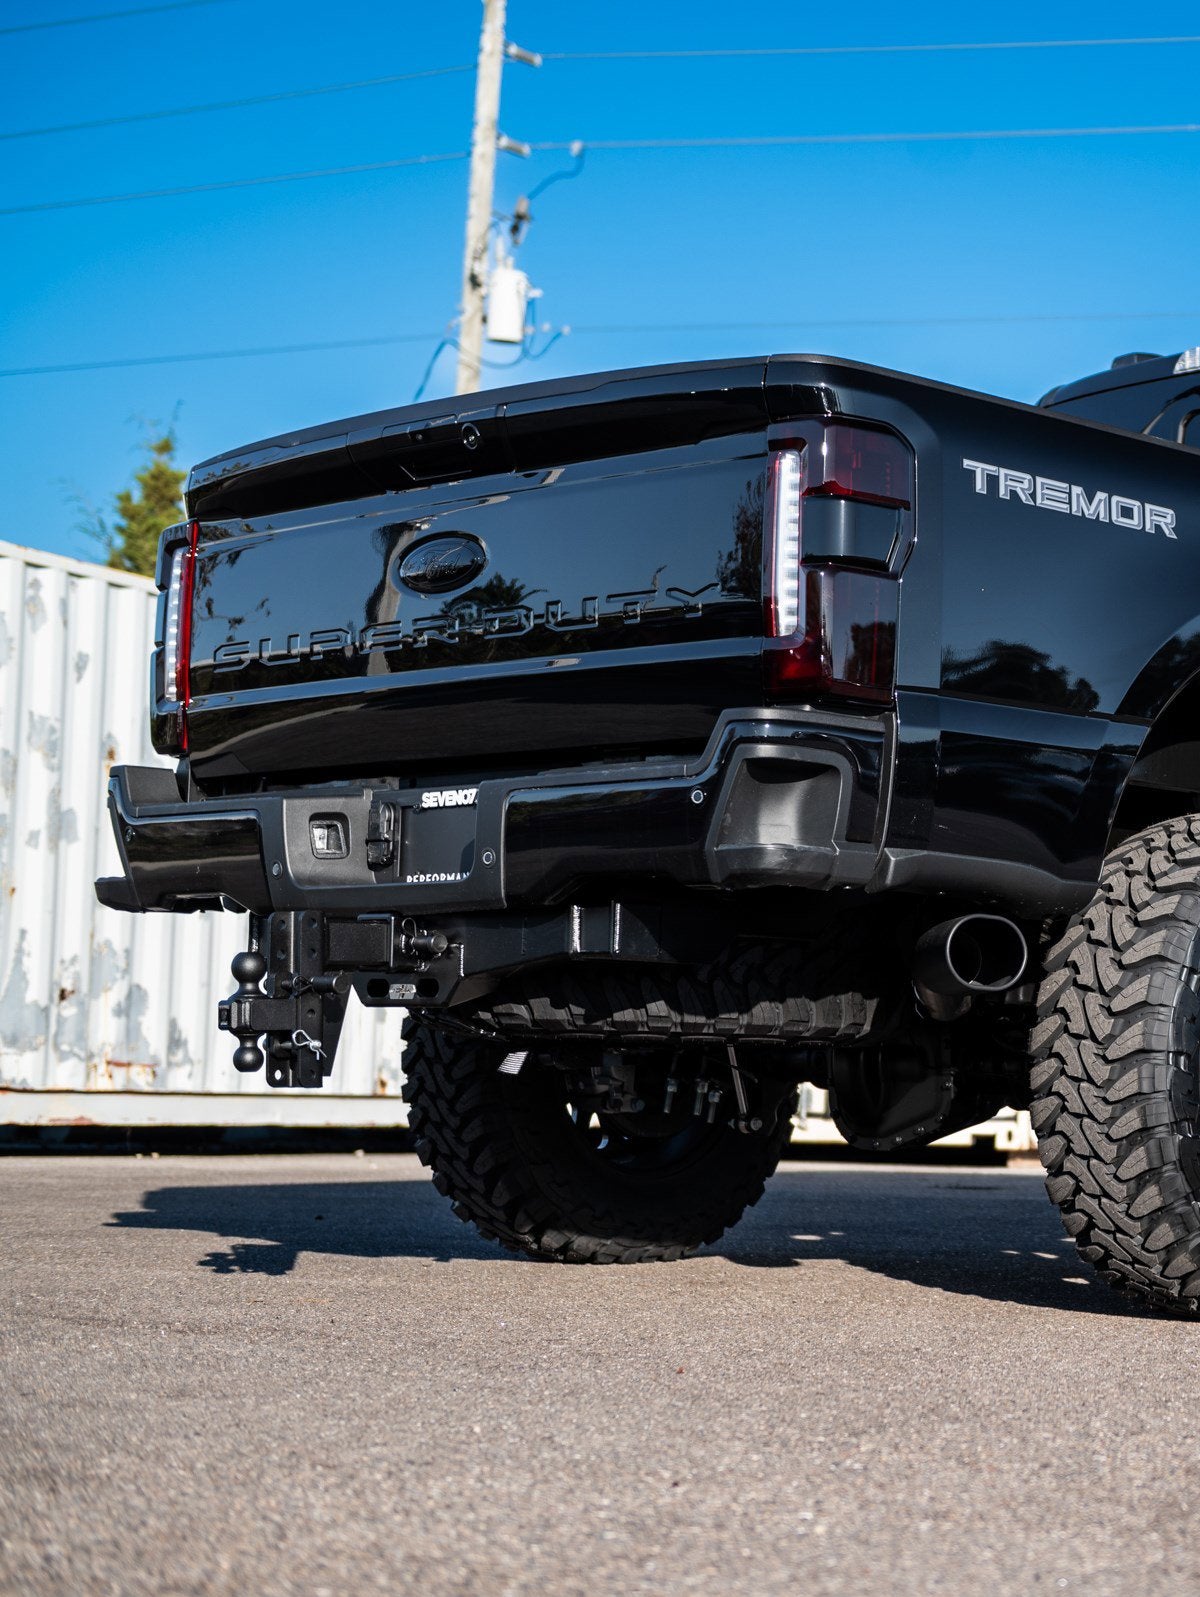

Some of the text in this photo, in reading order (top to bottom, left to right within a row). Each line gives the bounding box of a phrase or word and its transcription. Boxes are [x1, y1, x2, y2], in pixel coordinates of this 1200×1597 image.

[963, 459, 1178, 539] TREMOR
[213, 582, 720, 673] SUPER DUTY
